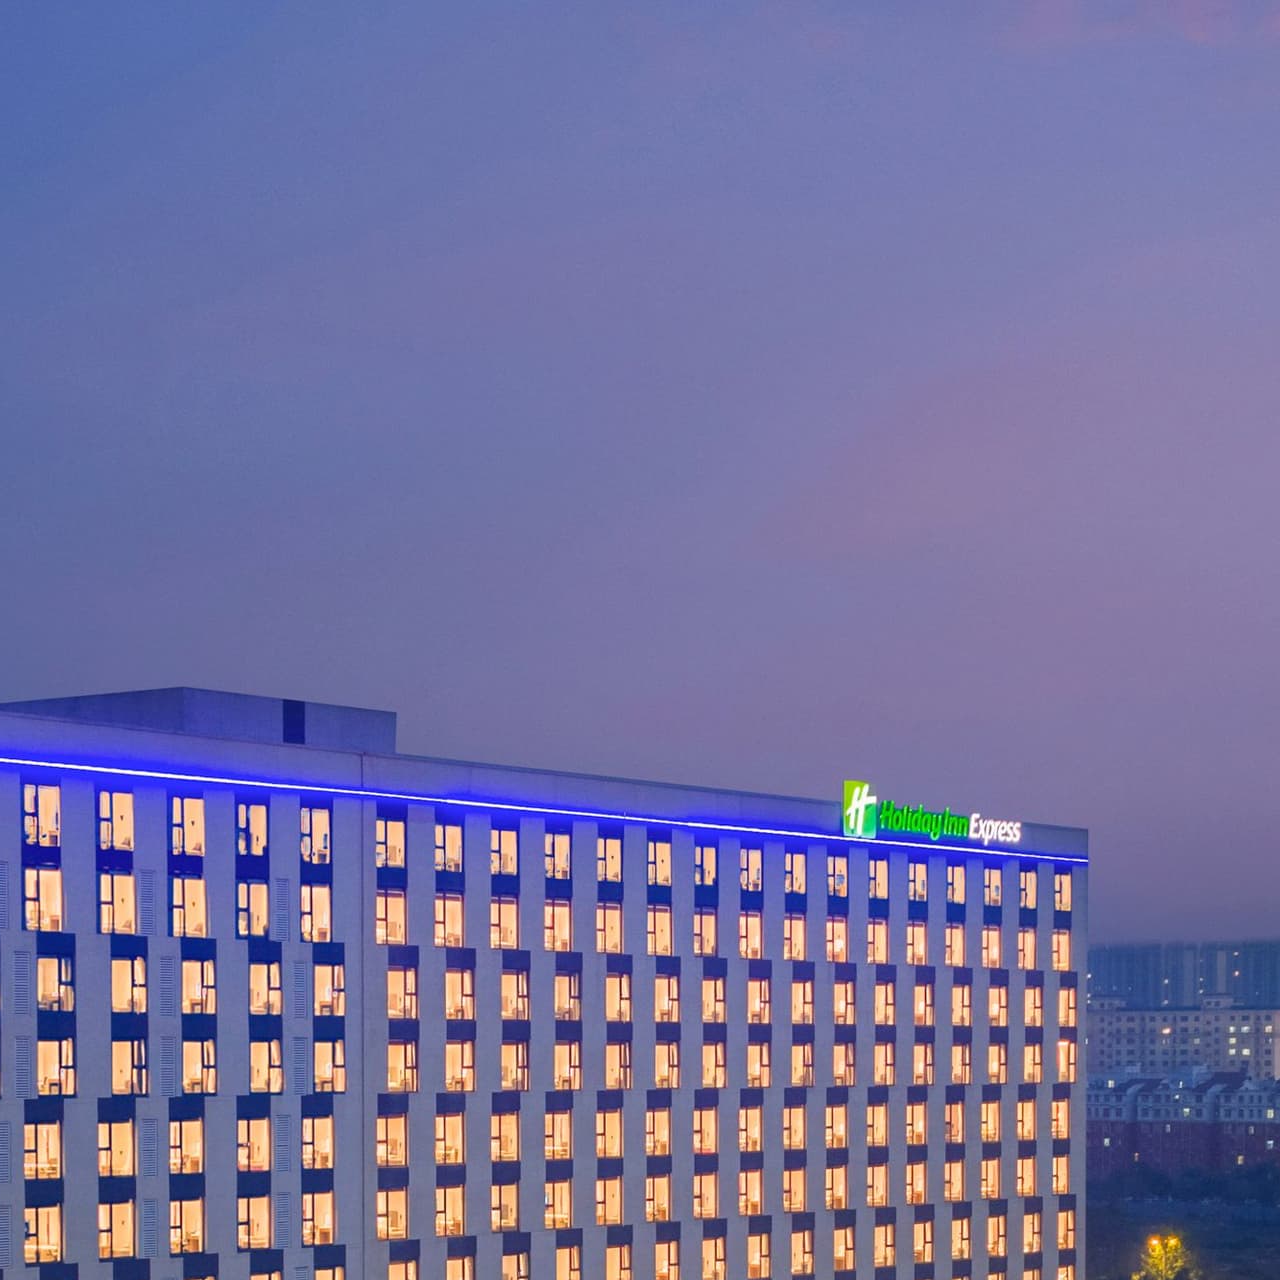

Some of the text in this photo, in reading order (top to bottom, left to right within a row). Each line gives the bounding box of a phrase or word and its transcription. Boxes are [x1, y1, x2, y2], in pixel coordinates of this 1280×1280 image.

[880, 800, 1022, 846] Holiday Inn Express
